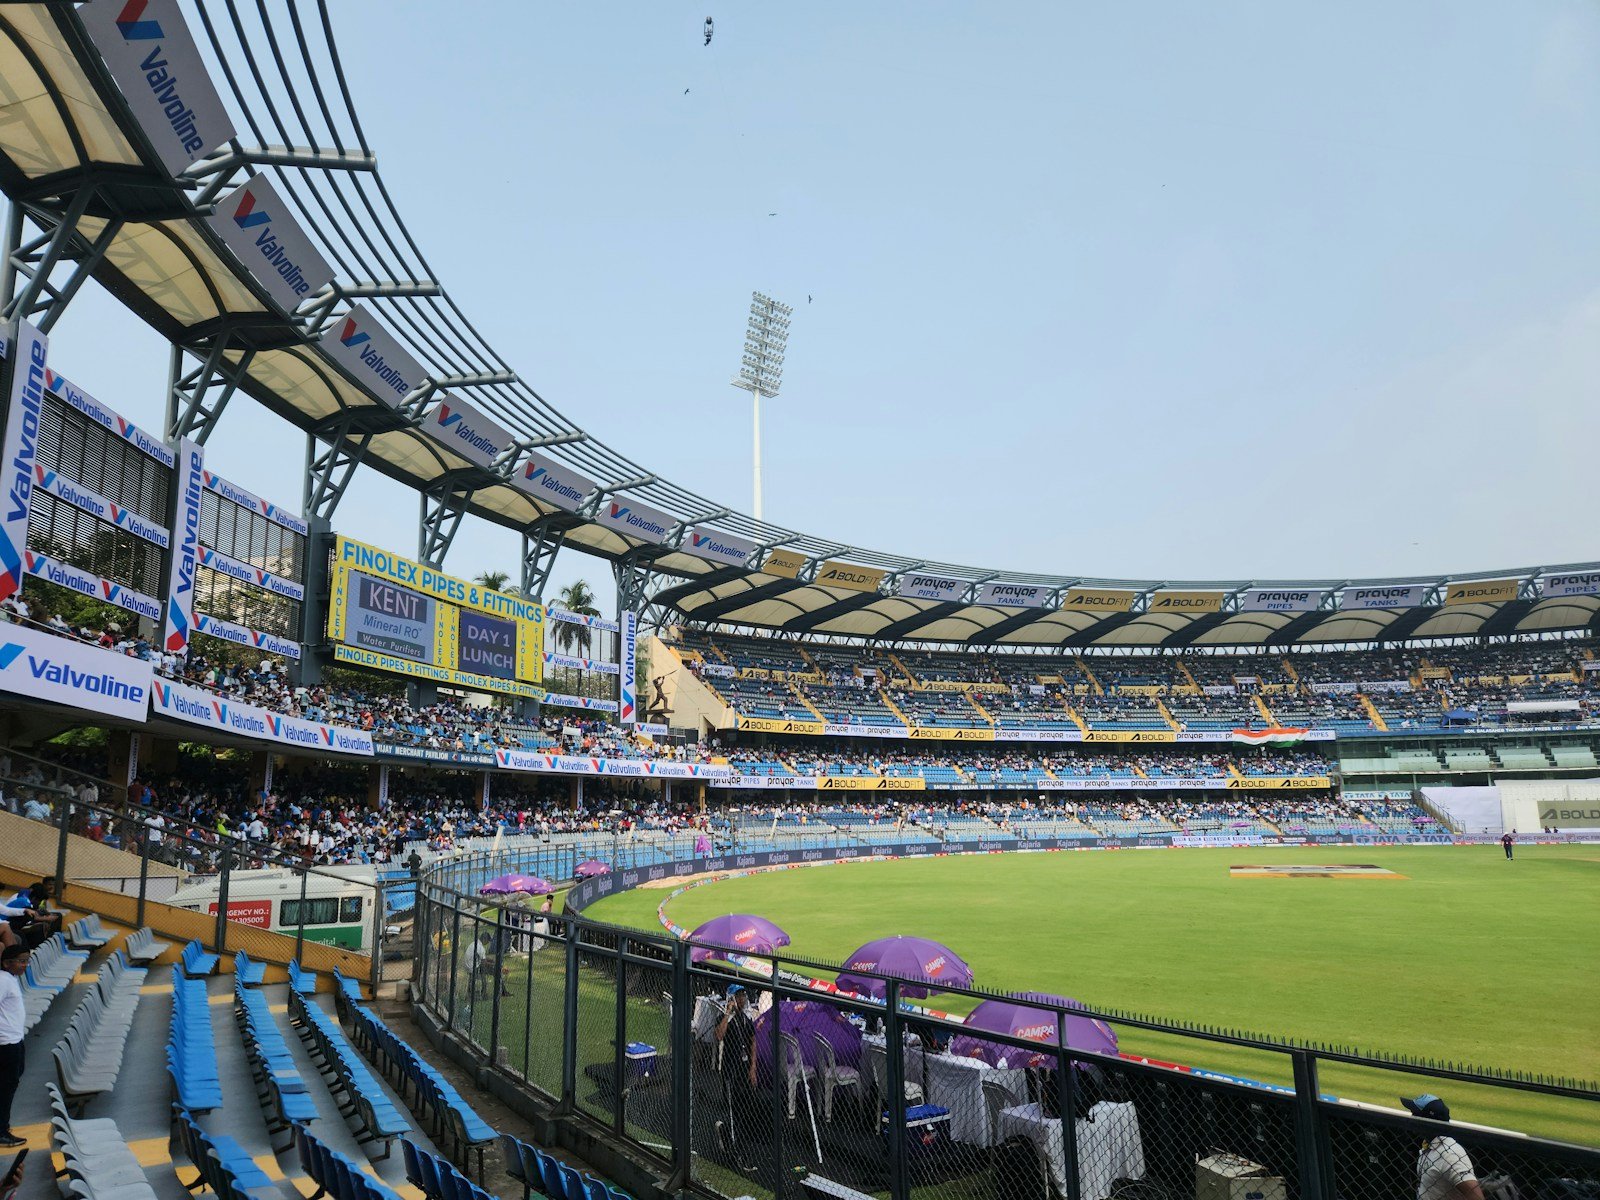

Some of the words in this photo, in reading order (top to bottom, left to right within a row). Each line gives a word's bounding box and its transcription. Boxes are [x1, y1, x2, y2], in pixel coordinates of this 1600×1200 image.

[140, 45, 204, 158] Valvoline
[255, 226, 310, 296] Valvoline
[359, 343, 409, 395] Valvoline
[7, 339, 46, 522] Valvoline
[65, 386, 112, 428] Valvoline
[135, 432, 173, 465] Valvoline
[455, 421, 498, 457] Valvoline
[540, 474, 582, 501] Valvoline
[57, 480, 104, 516] Valvoline
[128, 517, 167, 546] Valvoline
[220, 482, 257, 511] Valvoline
[275, 510, 306, 534] Valvoline
[177, 451, 202, 594] Valvoline
[626, 513, 665, 536] Valvoline
[707, 540, 746, 560] Valvoline
[214, 556, 252, 581] Valvoline
[270, 578, 302, 599] Valvoline
[343, 541, 418, 585] FINOLEX
[422, 570, 465, 600] PIPES
[469, 587, 479, 605] &
[483, 592, 542, 623] FITTINGS
[836, 571, 880, 585] BOLDFIT
[47, 564, 96, 595] Valvoline
[120, 592, 160, 619] Valvoline
[918, 589, 940, 598] PIPES
[1467, 586, 1514, 597] BOLDFIT
[1564, 585, 1597, 594] PIPES
[334, 566, 343, 638] FINOLEX
[369, 583, 419, 620] KENT
[997, 597, 1025, 605] TANKS
[1084, 597, 1130, 606] BOLDFIT
[1172, 599, 1218, 607] BOLDFIT
[363, 614, 402, 634] Mineral
[554, 611, 581, 624] Valvoline
[594, 619, 618, 631] Valvoline
[209, 622, 248, 644] Valvoline
[266, 638, 299, 658] Valvoline
[362, 634, 386, 647] Water
[390, 640, 421, 657] Purifiers
[467, 625, 499, 645] DAY
[503, 634, 510, 647] 1
[462, 646, 513, 669] LUNCH
[625, 614, 635, 686] Valvoline
[336, 647, 378, 666] FINOLEX
[380, 657, 405, 671] PIPES
[407, 663, 413, 673] &
[414, 664, 449, 680] FITTINGS
[454, 672, 488, 688] FINOLEX
[489, 680, 511, 692] PIPES
[519, 685, 544, 698] FITTINGS
[553, 657, 580, 668] Valvoline
[593, 663, 618, 673] Valvoline
[28, 655, 144, 703] Valvoline
[552, 696, 579, 707] Valvoline
[592, 702, 617, 711] Valvoline
[172, 693, 211, 720] Valvoline
[228, 710, 265, 733] Valvoline
[282, 723, 319, 745] Valvoline
[335, 735, 371, 752] Valvoline
[751, 721, 780, 730] BOLDFIT
[793, 724, 823, 732] BOLDFIT
[920, 729, 950, 737] BOLDFIT
[963, 731, 993, 739] BOLDFIT
[1095, 733, 1127, 741] BOLDFIT
[1142, 733, 1174, 741] BOLDFIT
[376, 744, 393, 754] VIJAY
[395, 746, 424, 758] MERCHANT
[511, 756, 543, 769] Valvoline
[559, 760, 589, 772] Valvoline
[607, 763, 642, 775] Valvoline
[656, 766, 686, 776] Valvoline
[700, 768, 728, 777] Valvoline
[796, 778, 814, 786] TANKS
[835, 779, 866, 788] BOLDFIT
[888, 780, 920, 789] BOLDFIT
[871, 845, 892, 856] Kajaria
[905, 844, 927, 854] Kajaria
[941, 843, 963, 852] Kajaria
[979, 841, 1002, 851] Kajaria
[1017, 840, 1041, 850] Kajaria
[1056, 839, 1080, 848] Kajaria
[1097, 837, 1121, 847] Kajaria
[1138, 836, 1164, 846] Kajaria
[768, 852, 789, 864] Kajaria
[802, 850, 822, 861] Kajaria
[835, 848, 857, 859] Kajaria
[734, 928, 757, 942] CAMPA
[925, 956, 945, 974] CAMPA
[1017, 1024, 1054, 1038] CAMPA
